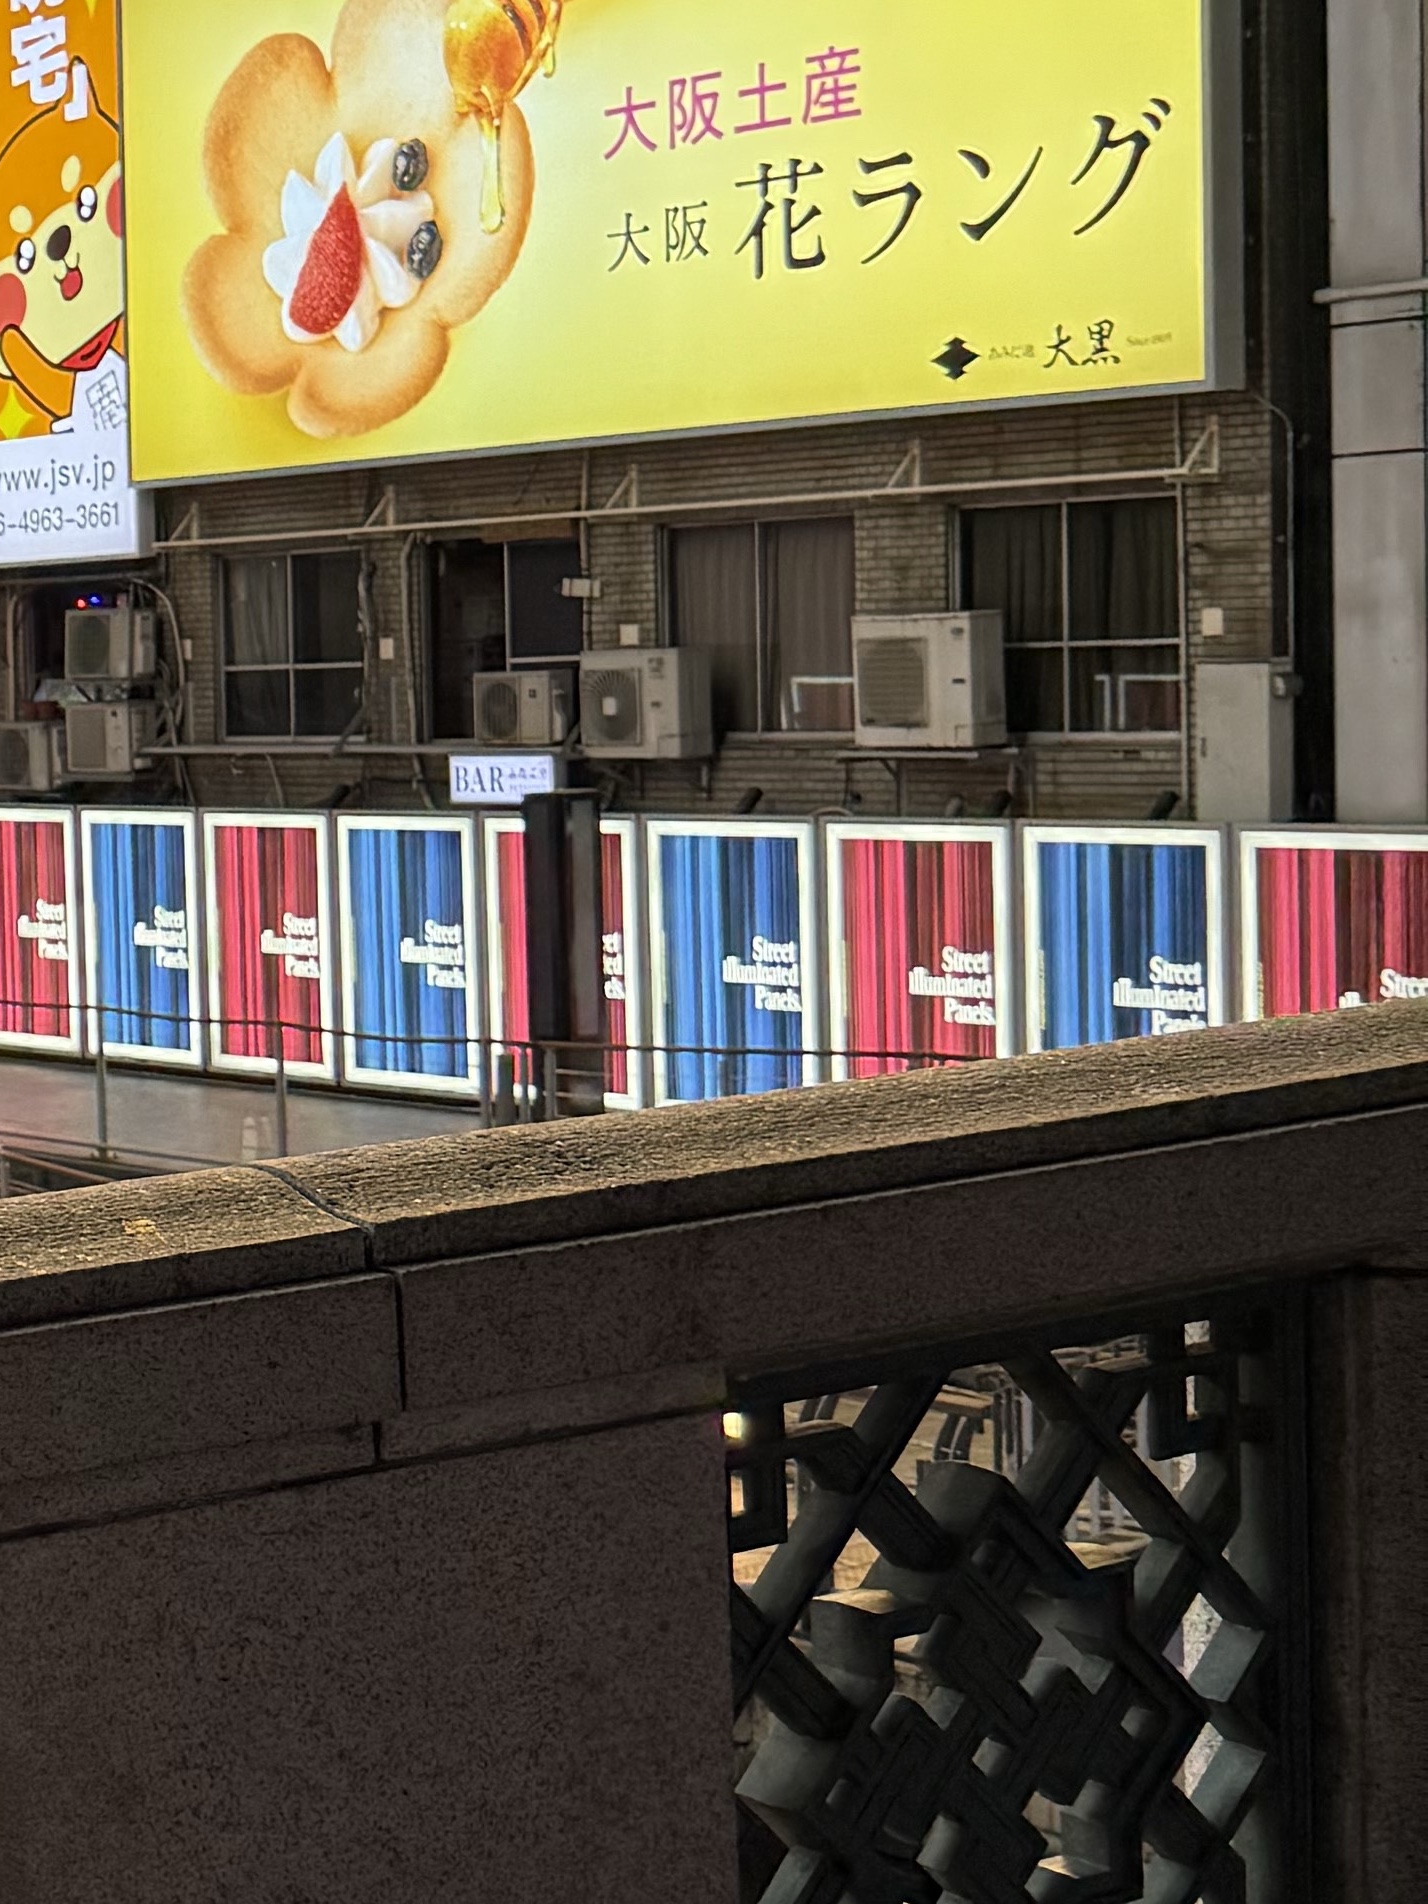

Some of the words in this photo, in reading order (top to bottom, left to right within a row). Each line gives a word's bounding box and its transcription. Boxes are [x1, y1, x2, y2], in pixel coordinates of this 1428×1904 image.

[602, 44, 864, 161] 大阪土産
[606, 200, 709, 274] 大阪
[733, 96, 1172, 281] 花ラング
[1042, 318, 1122, 369] 大黒
[455, 764, 505, 794] BAR
[752, 935, 796, 964] Street
[942, 946, 990, 975] Street
[1149, 956, 1202, 986] Street
